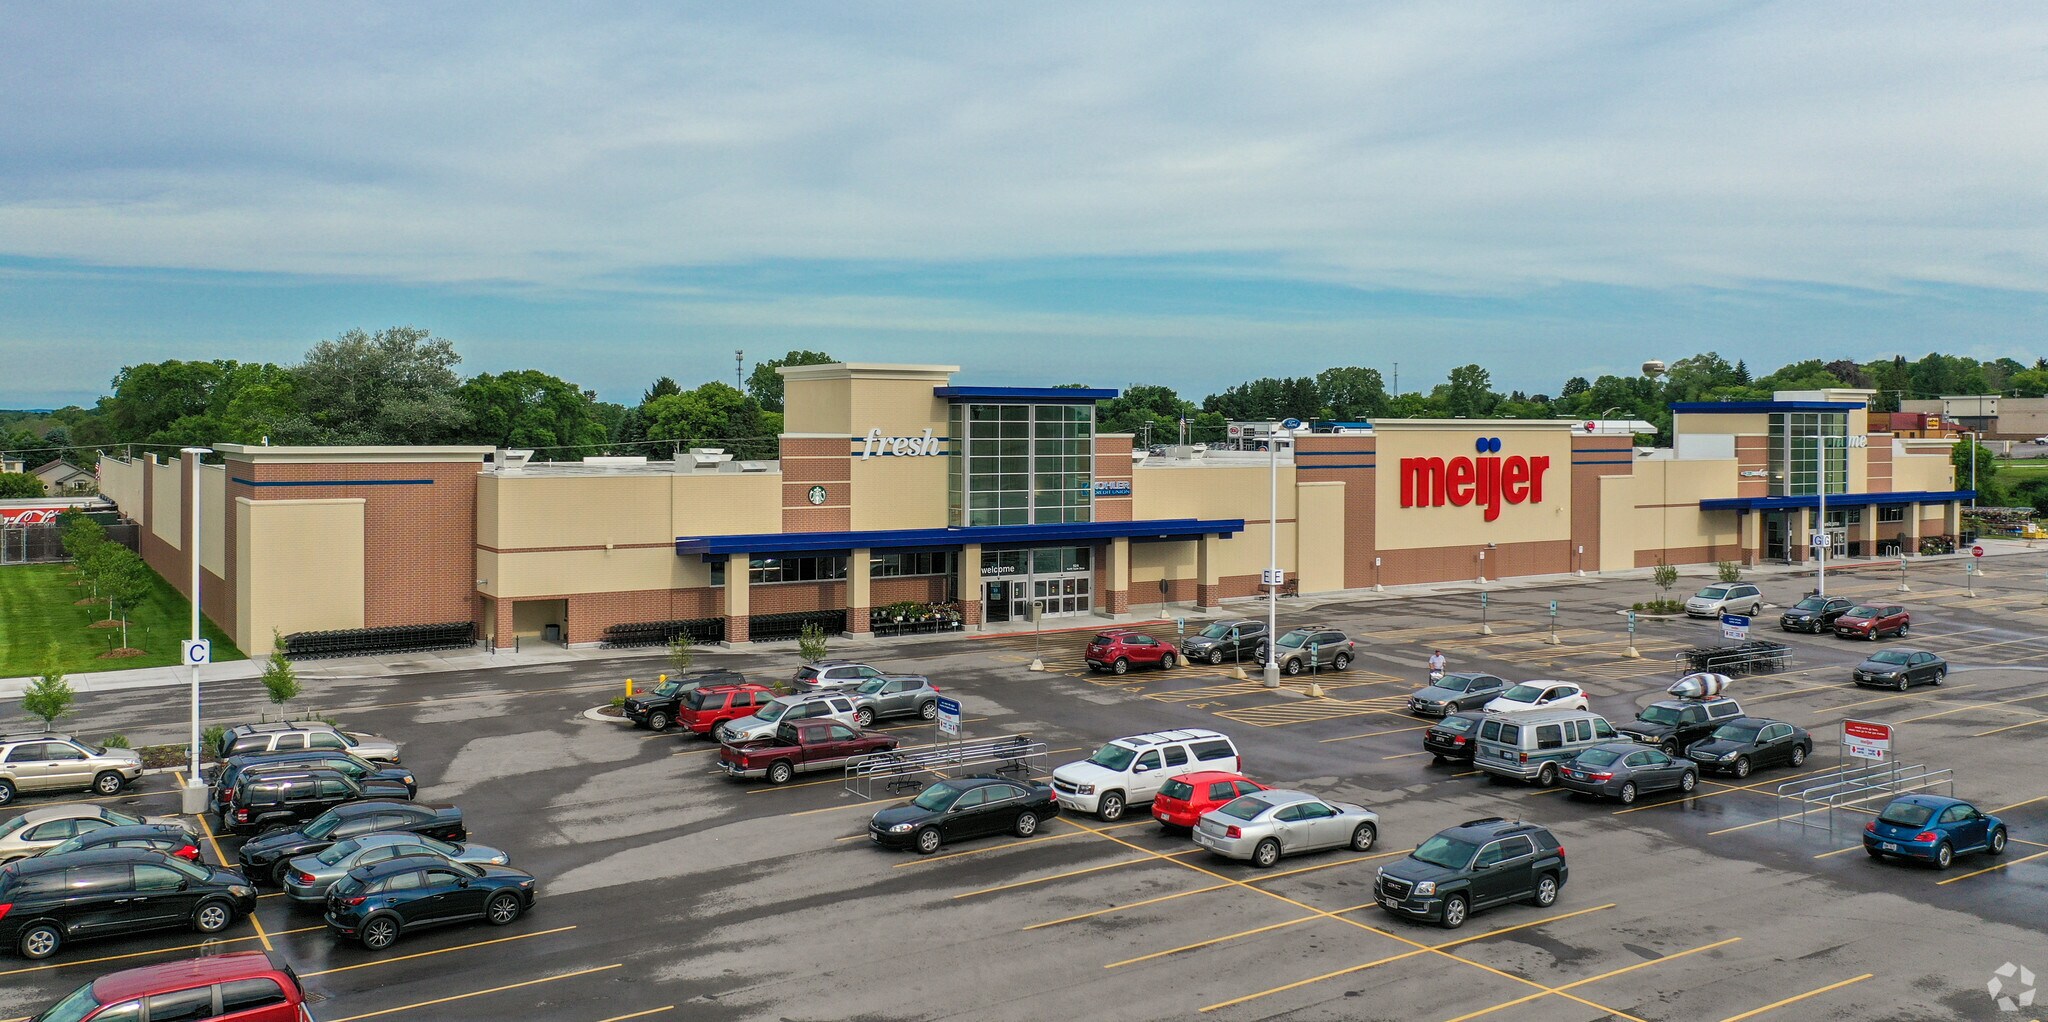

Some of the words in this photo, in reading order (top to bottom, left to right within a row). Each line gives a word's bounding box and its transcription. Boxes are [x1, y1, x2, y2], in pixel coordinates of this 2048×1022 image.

[861, 428, 940, 461] fresh
[1400, 437, 1549, 522] meijer
[1814, 535, 1822, 546] G
[1824, 535, 1830, 546] G
[981, 564, 1015, 574] welcome
[1264, 570, 1270, 583] E
[1275, 570, 1281, 583] E
[190, 644, 205, 662] C
[1387, 882, 1401, 890] GMC
